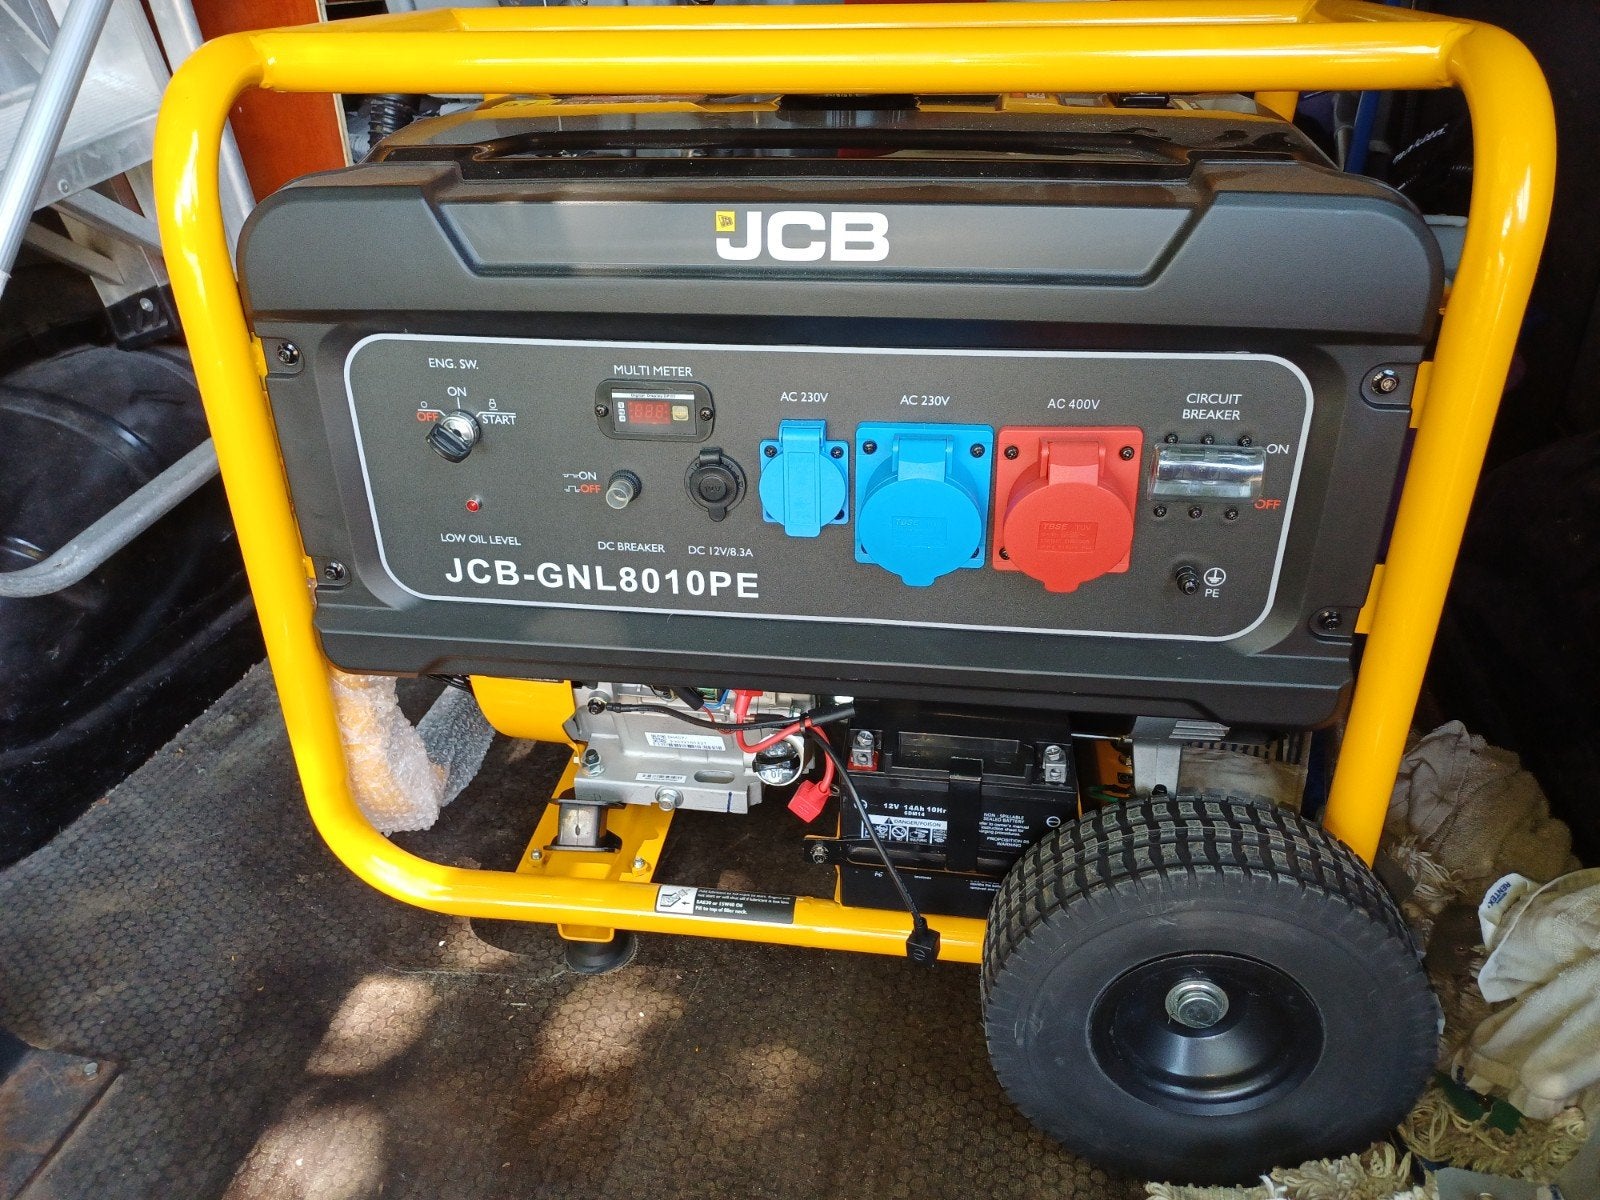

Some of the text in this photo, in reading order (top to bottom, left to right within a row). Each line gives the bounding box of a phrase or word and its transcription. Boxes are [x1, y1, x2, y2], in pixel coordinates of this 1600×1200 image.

[716, 211, 890, 261] JCB
[428, 358, 478, 370] ENG. SW.
[614, 365, 693, 376] MULTI METER
[447, 386, 466, 397] ON
[780, 392, 828, 402] AC 230V
[900, 395, 950, 406] AC 230V
[1047, 398, 1100, 410] AC 400V
[1186, 394, 1242, 404] CIRCUIT
[416, 412, 439, 422] OFF
[482, 415, 516, 425] START
[1182, 409, 1240, 420] BREAKER
[1266, 444, 1290, 454] ON
[578, 472, 597, 480] ON
[580, 484, 600, 493] OFF
[1254, 500, 1282, 510] OFF
[440, 533, 522, 546] LOW OIL LEVEL
[598, 541, 666, 553] DC BREAKER
[688, 546, 754, 557] DC 12V/8.3A
[445, 558, 759, 598] JCB-GNL8010PE
[1204, 588, 1220, 598] PE
